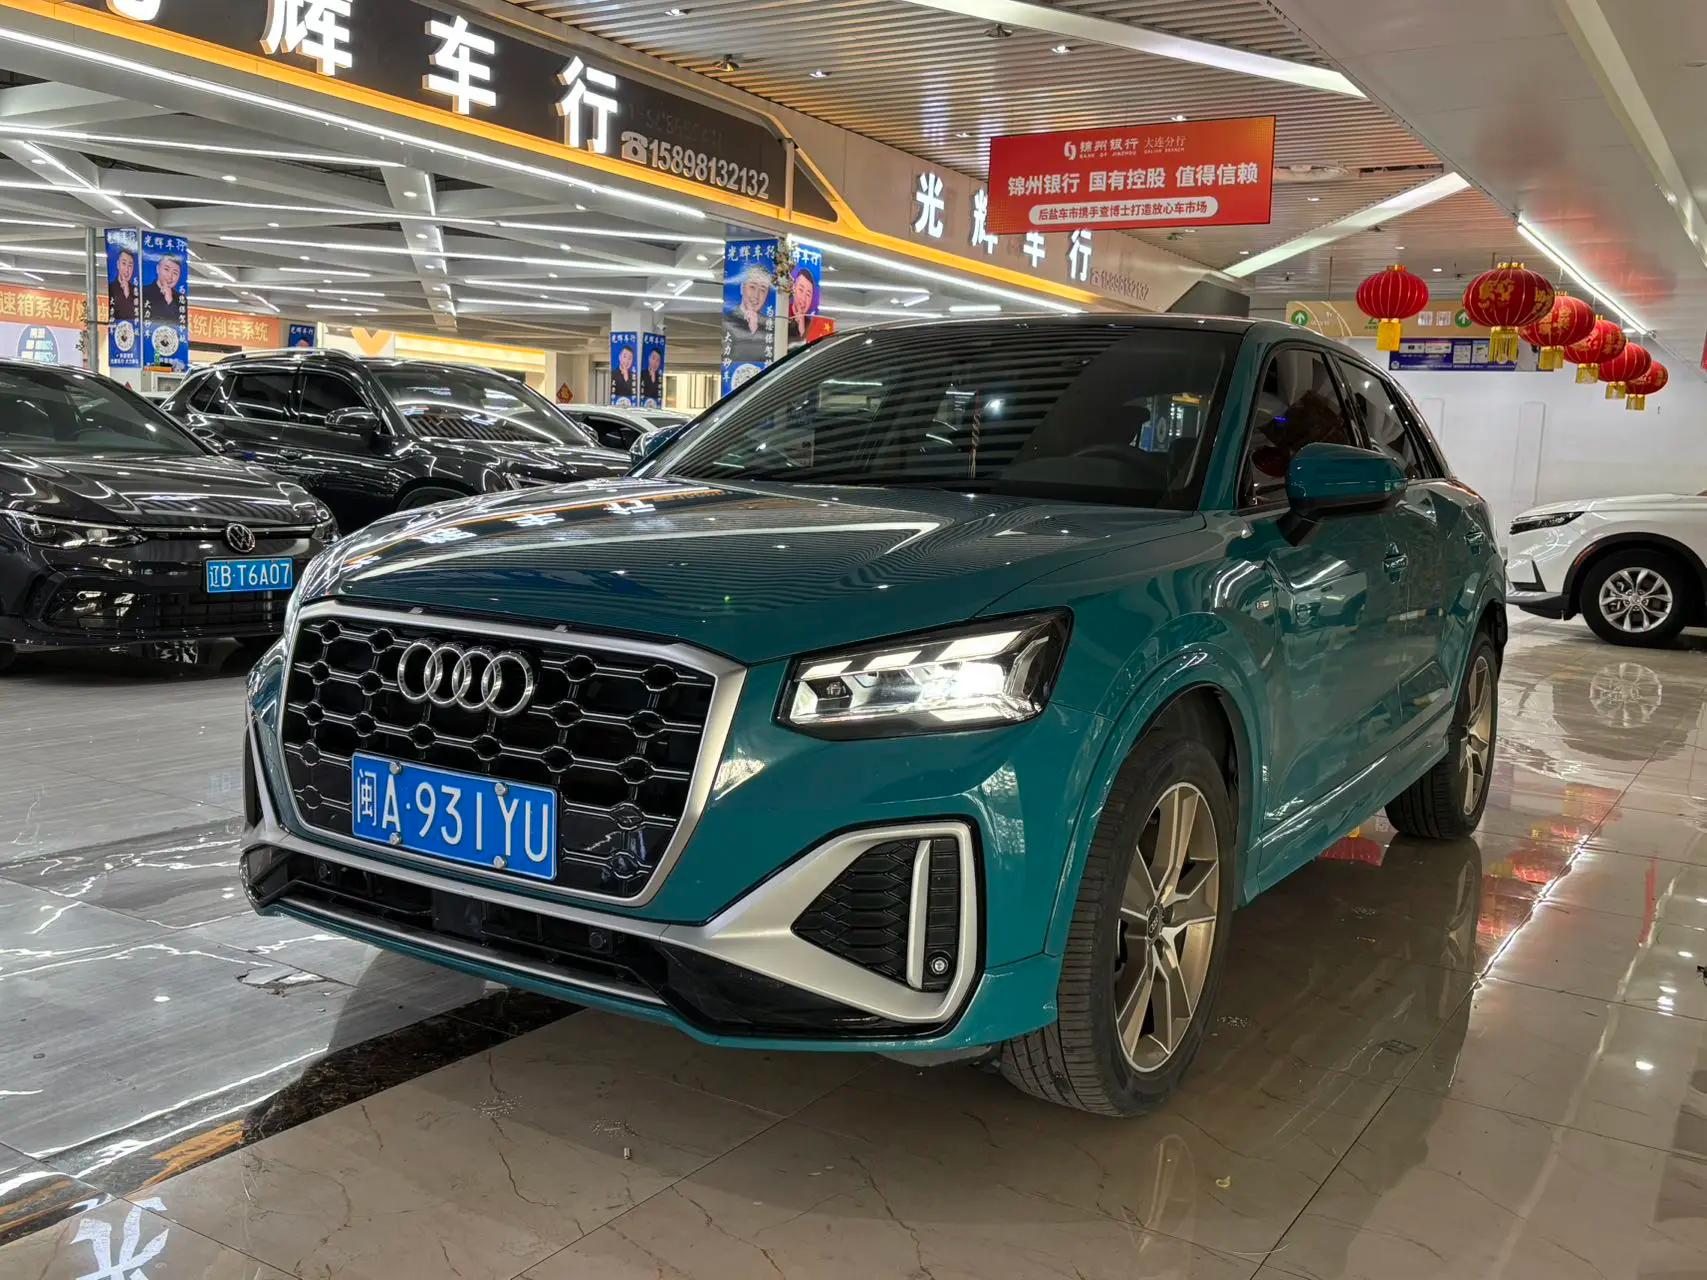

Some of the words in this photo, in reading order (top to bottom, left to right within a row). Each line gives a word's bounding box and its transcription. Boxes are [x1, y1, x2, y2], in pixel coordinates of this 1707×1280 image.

[106, 0, 617, 153] 辉车行
[649, 139, 769, 199] 15898132132
[1080, 138, 1138, 152] 锦州银行
[1144, 136, 1186, 148] 大连分行
[1008, 173, 1080, 197] 锦州银行
[1089, 168, 1165, 192] 国有控股
[1176, 162, 1258, 188] 值得信赖
[357, 768, 549, 863] 闽A·931YU
